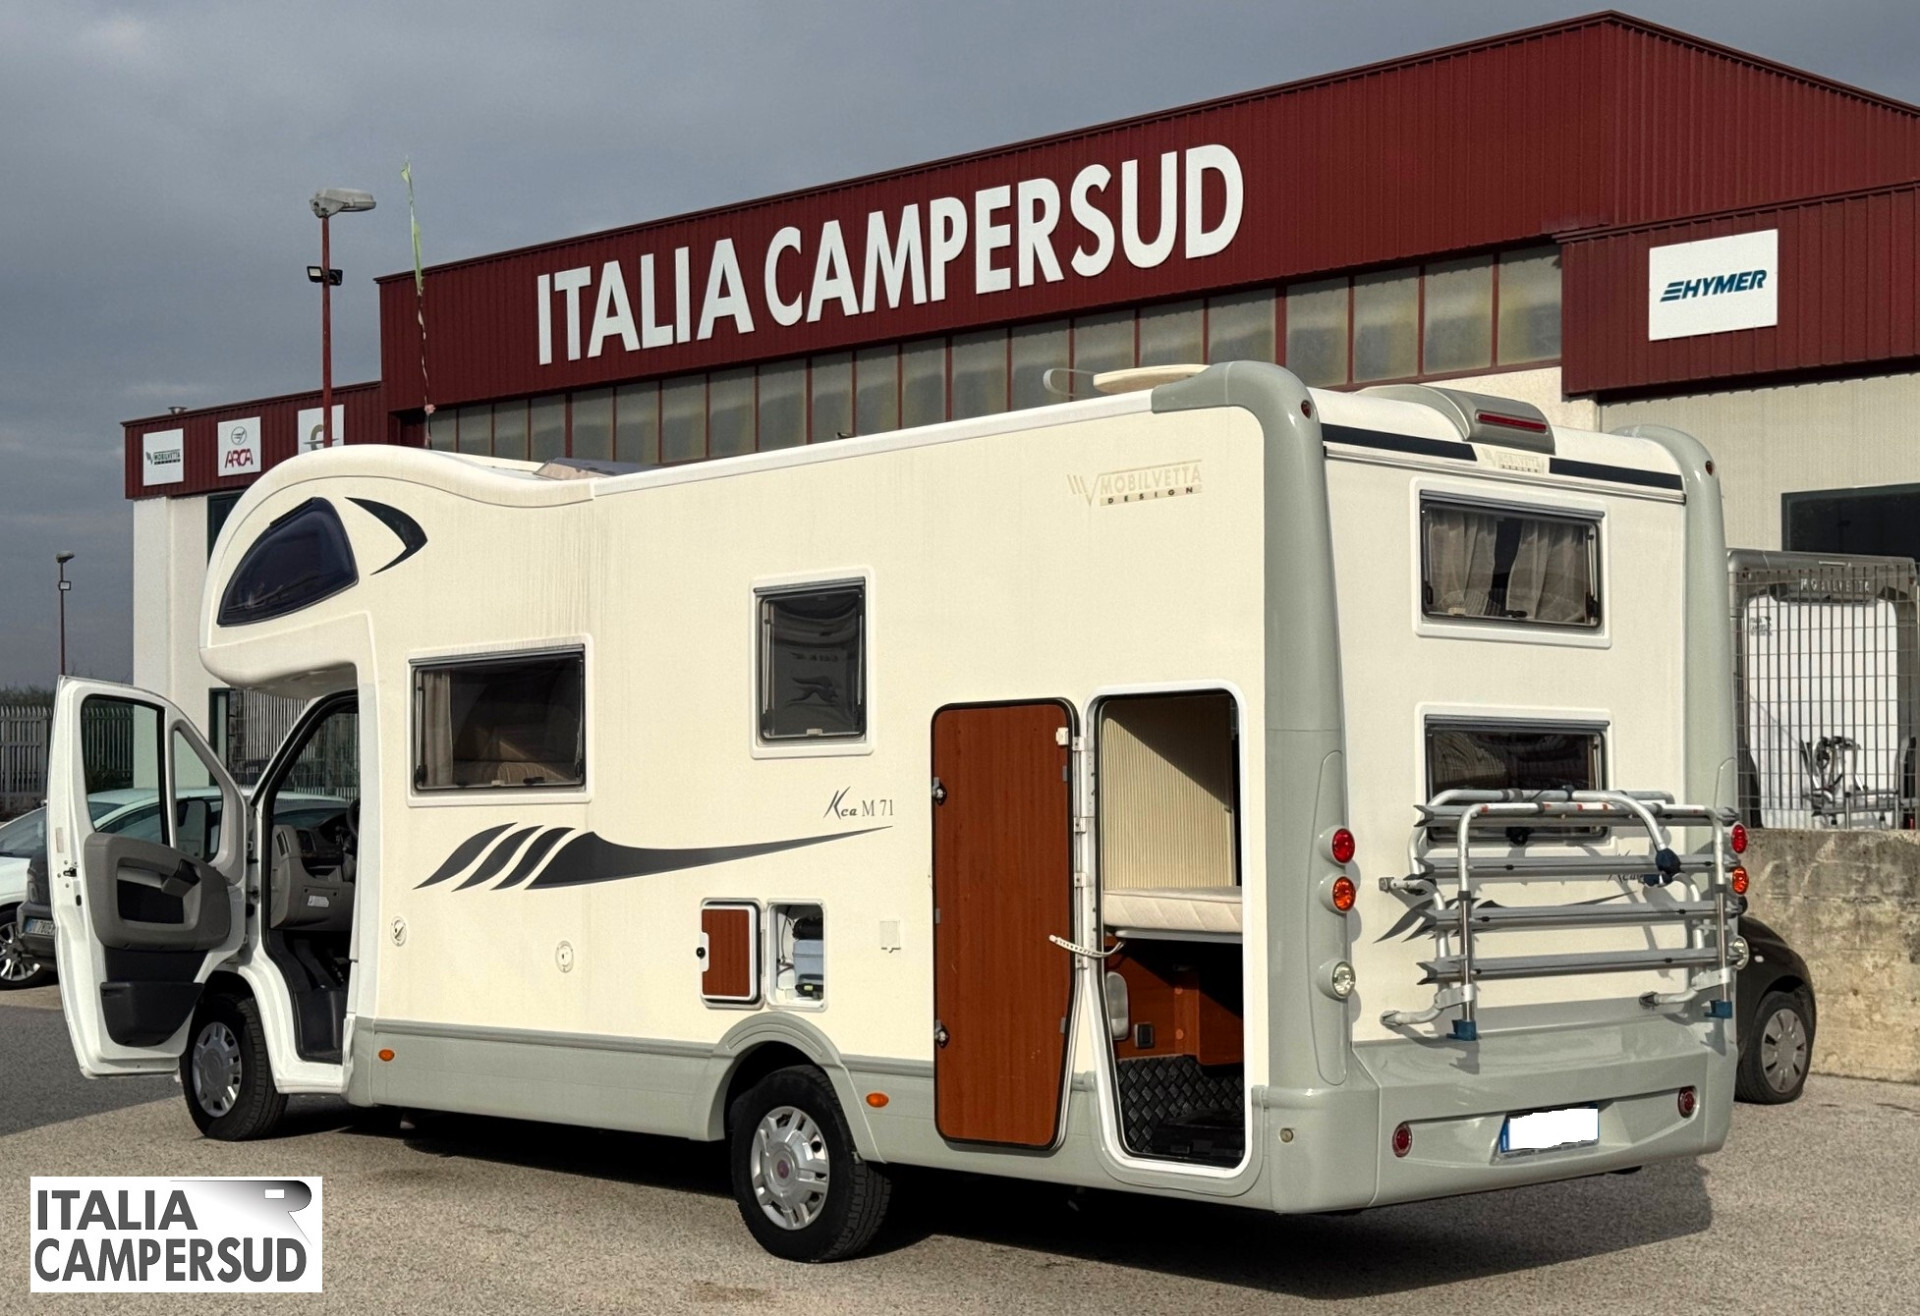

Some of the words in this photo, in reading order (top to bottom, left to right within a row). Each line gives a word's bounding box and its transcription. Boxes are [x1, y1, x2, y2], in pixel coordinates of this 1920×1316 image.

[537, 238, 755, 365] ITALIA
[764, 144, 1244, 327] CAMPERSUD
[1681, 269, 1768, 300] HYMER
[224, 448, 254, 469] ARCA
[1100, 463, 1202, 495] MOBILVETTA
[1107, 486, 1194, 504] DESIGN
[862, 799, 876, 817] M
[879, 799, 894, 816] 71
